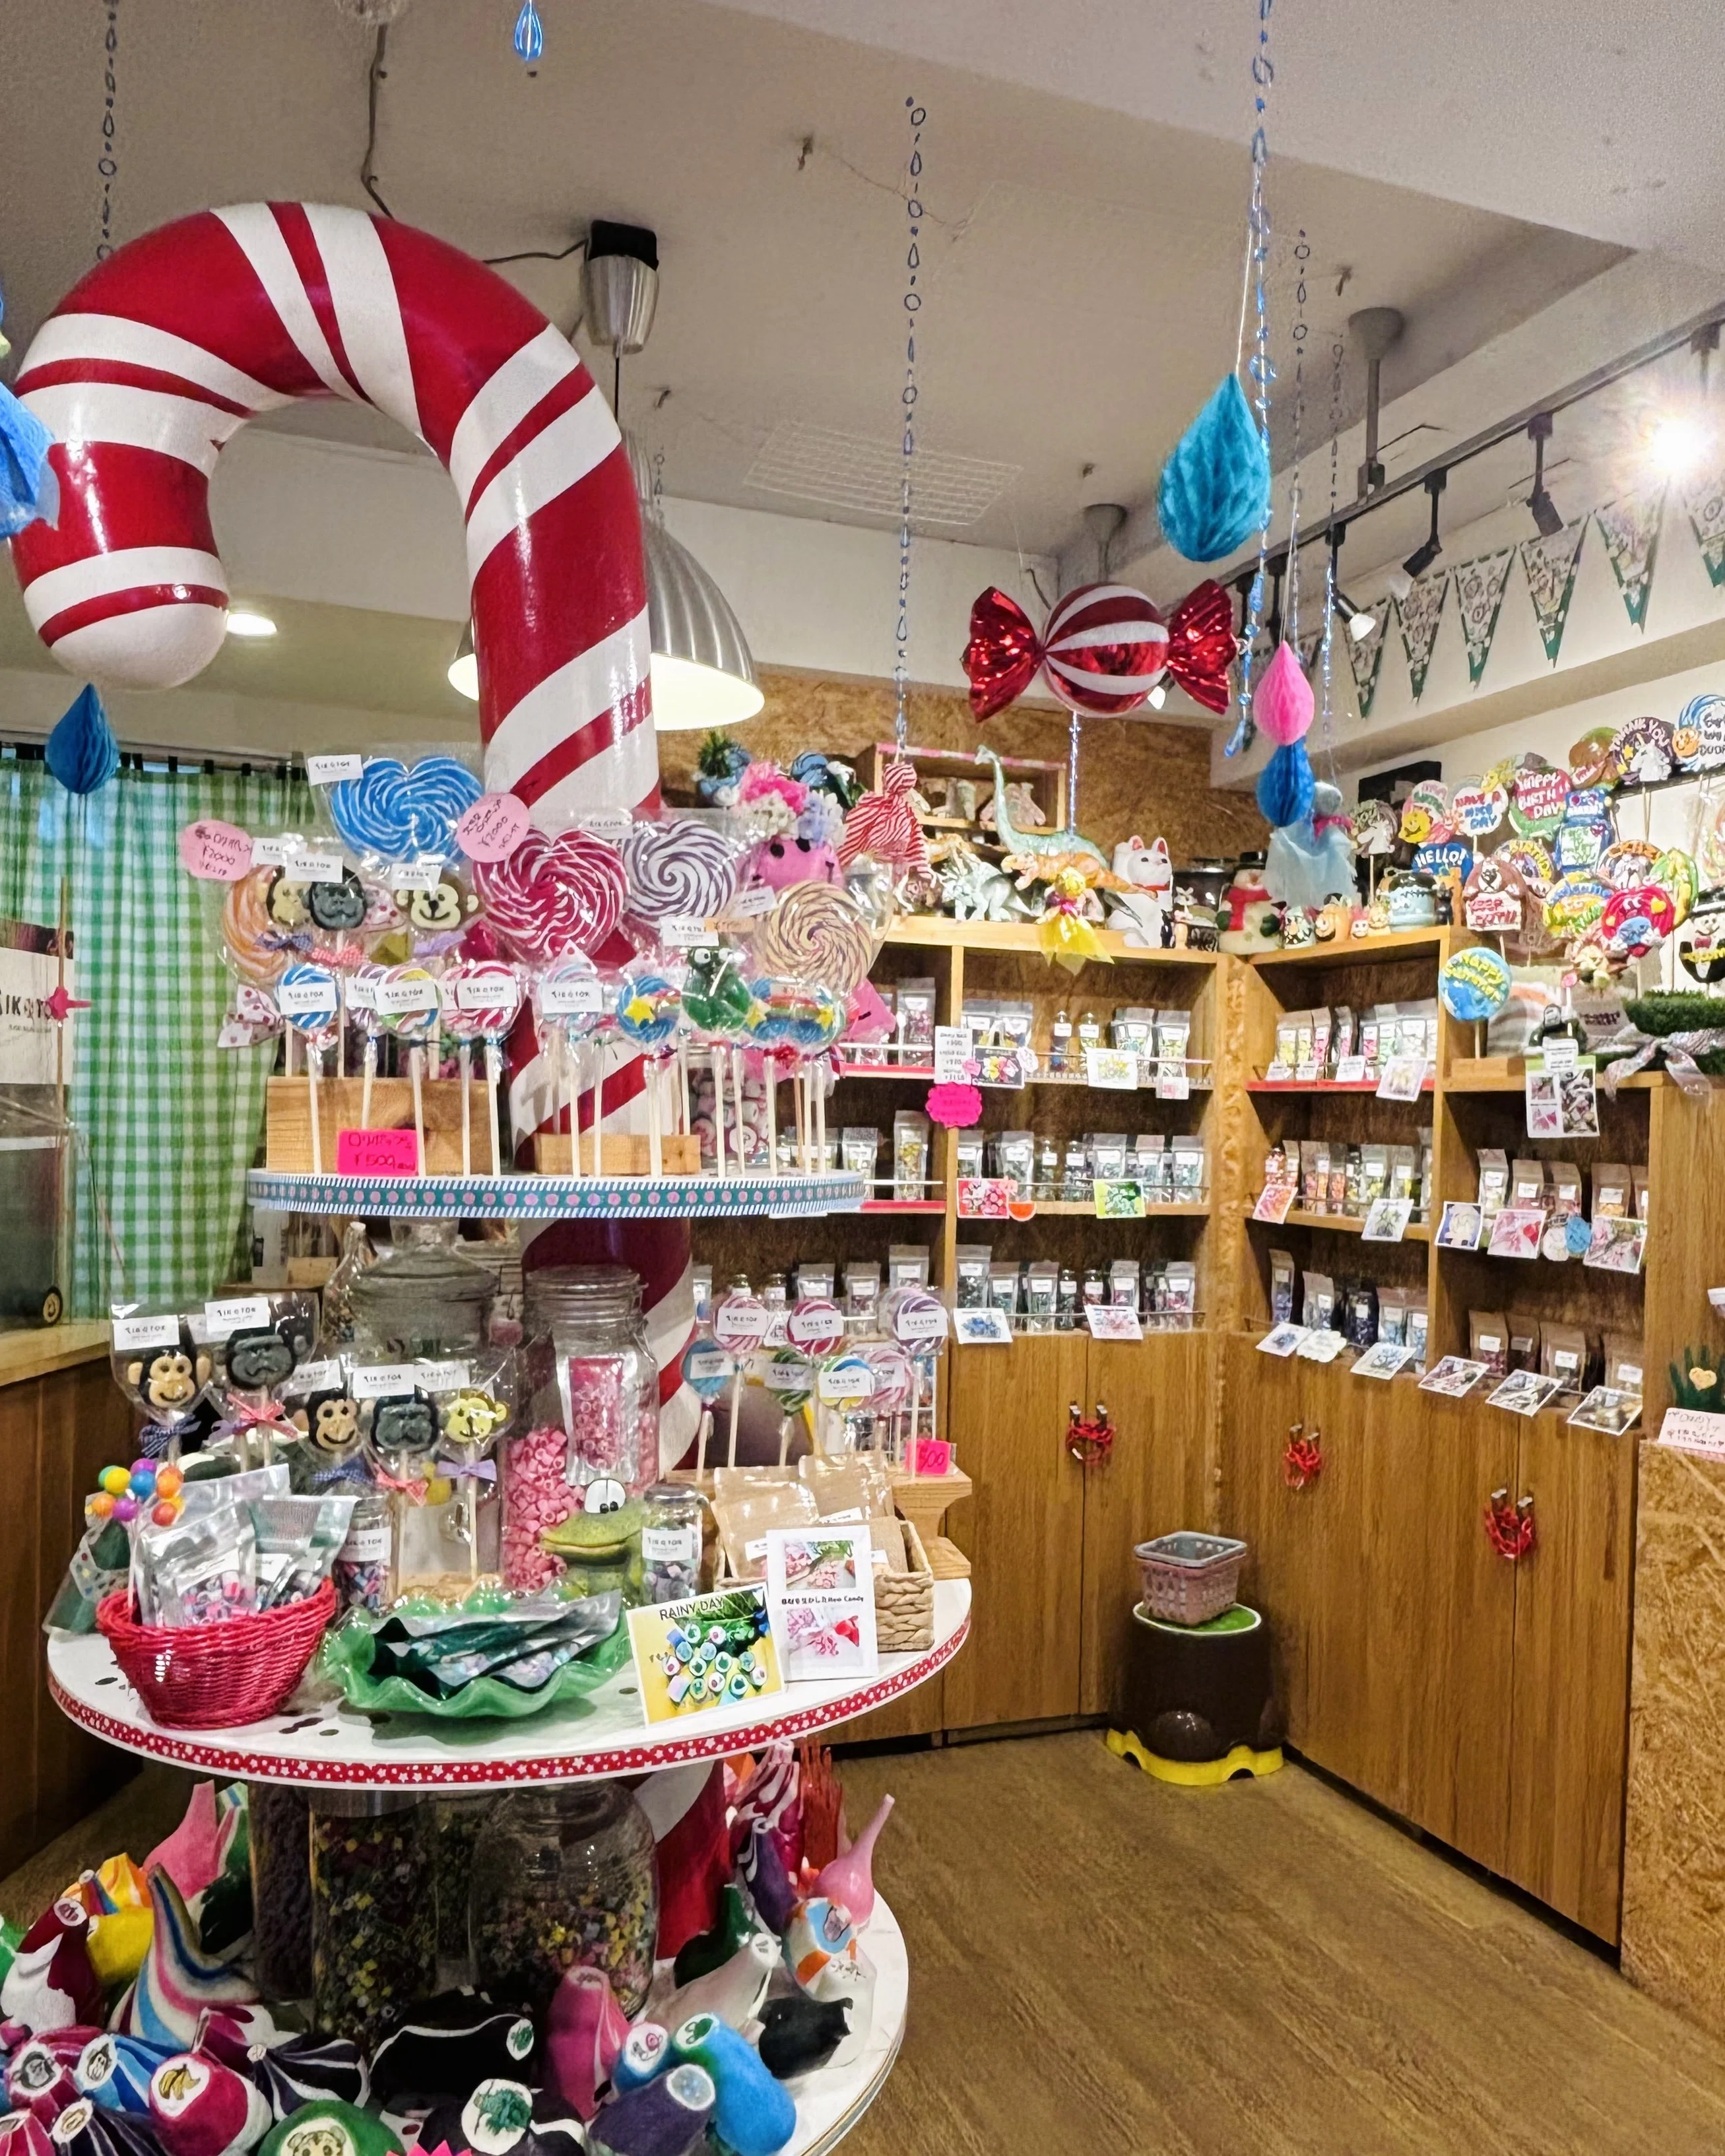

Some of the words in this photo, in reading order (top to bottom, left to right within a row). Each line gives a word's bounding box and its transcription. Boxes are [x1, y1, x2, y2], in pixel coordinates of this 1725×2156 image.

[1649, 719, 1670, 747] YOU
[1414, 847, 1466, 870] HELLO!
[660, 1603, 696, 1620] RAINY
[700, 1598, 723, 1610] DAY
